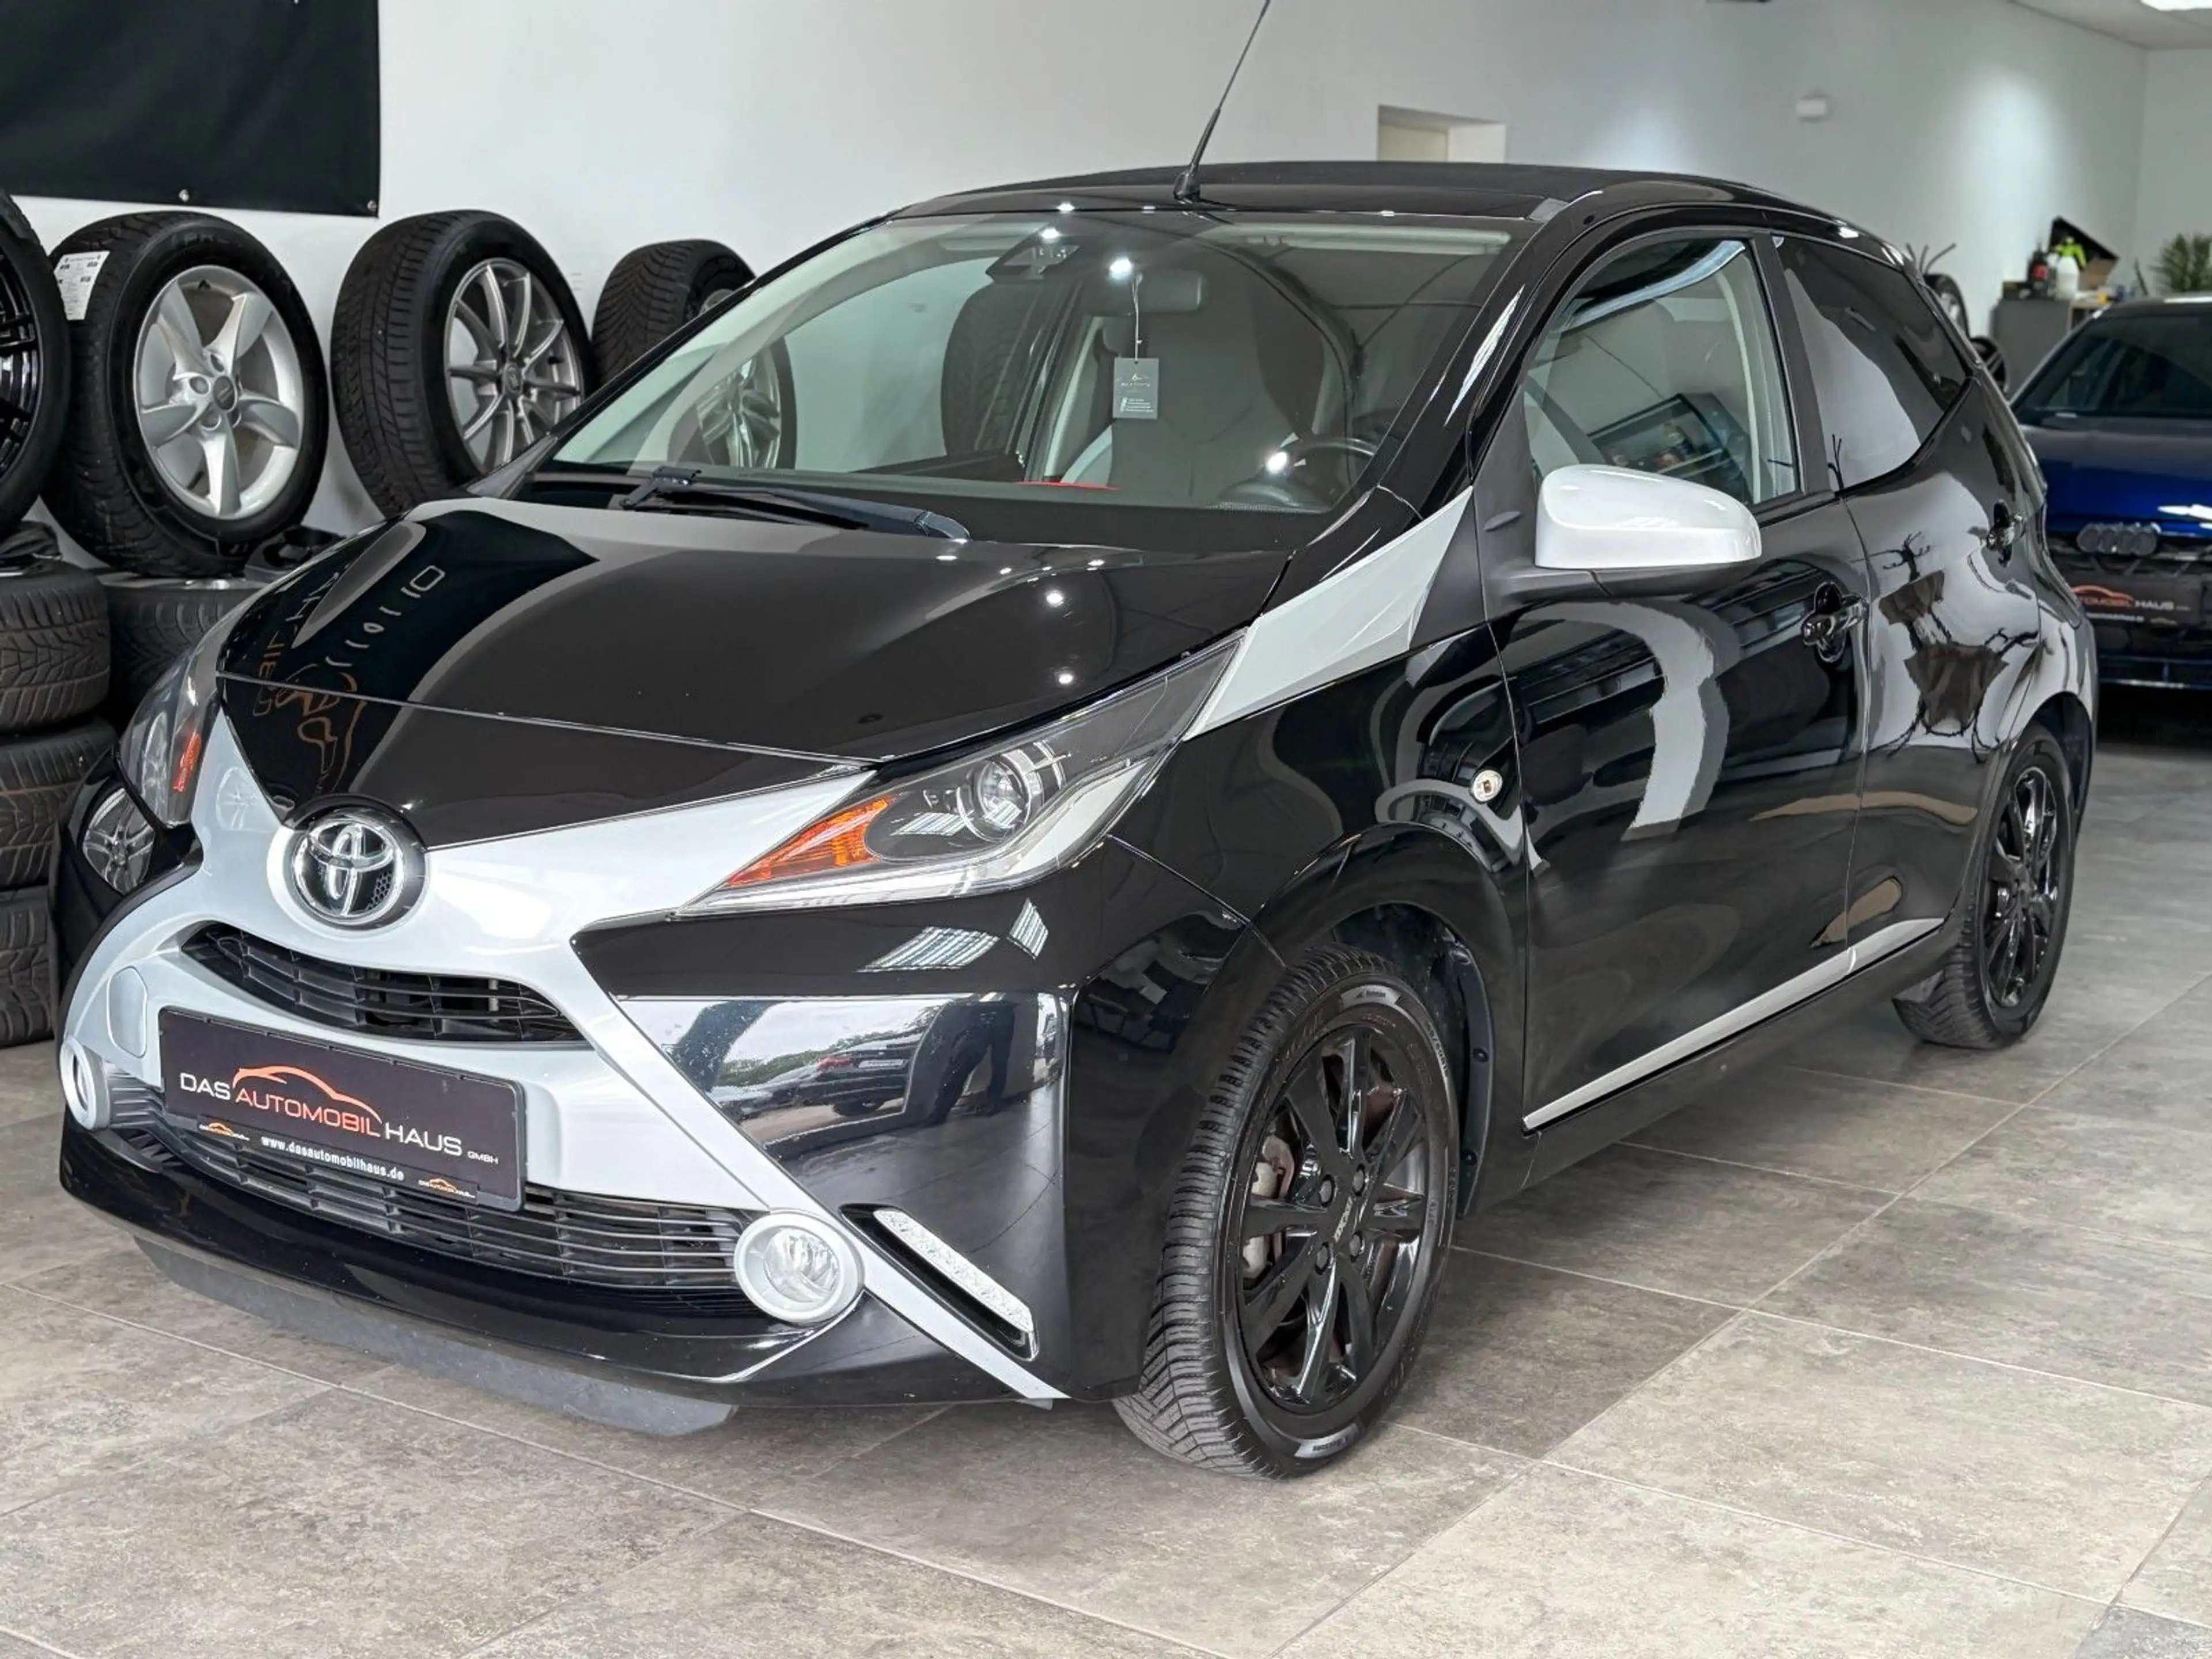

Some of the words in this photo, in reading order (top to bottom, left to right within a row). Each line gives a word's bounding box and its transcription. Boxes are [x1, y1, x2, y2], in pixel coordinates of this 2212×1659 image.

[180, 1072, 230, 1100] DAS
[235, 1088, 381, 1138] AUTOMOBIL
[385, 1122, 463, 1157] HAUS
[260, 1136, 404, 1181] www.dasautomobilhaus.de
